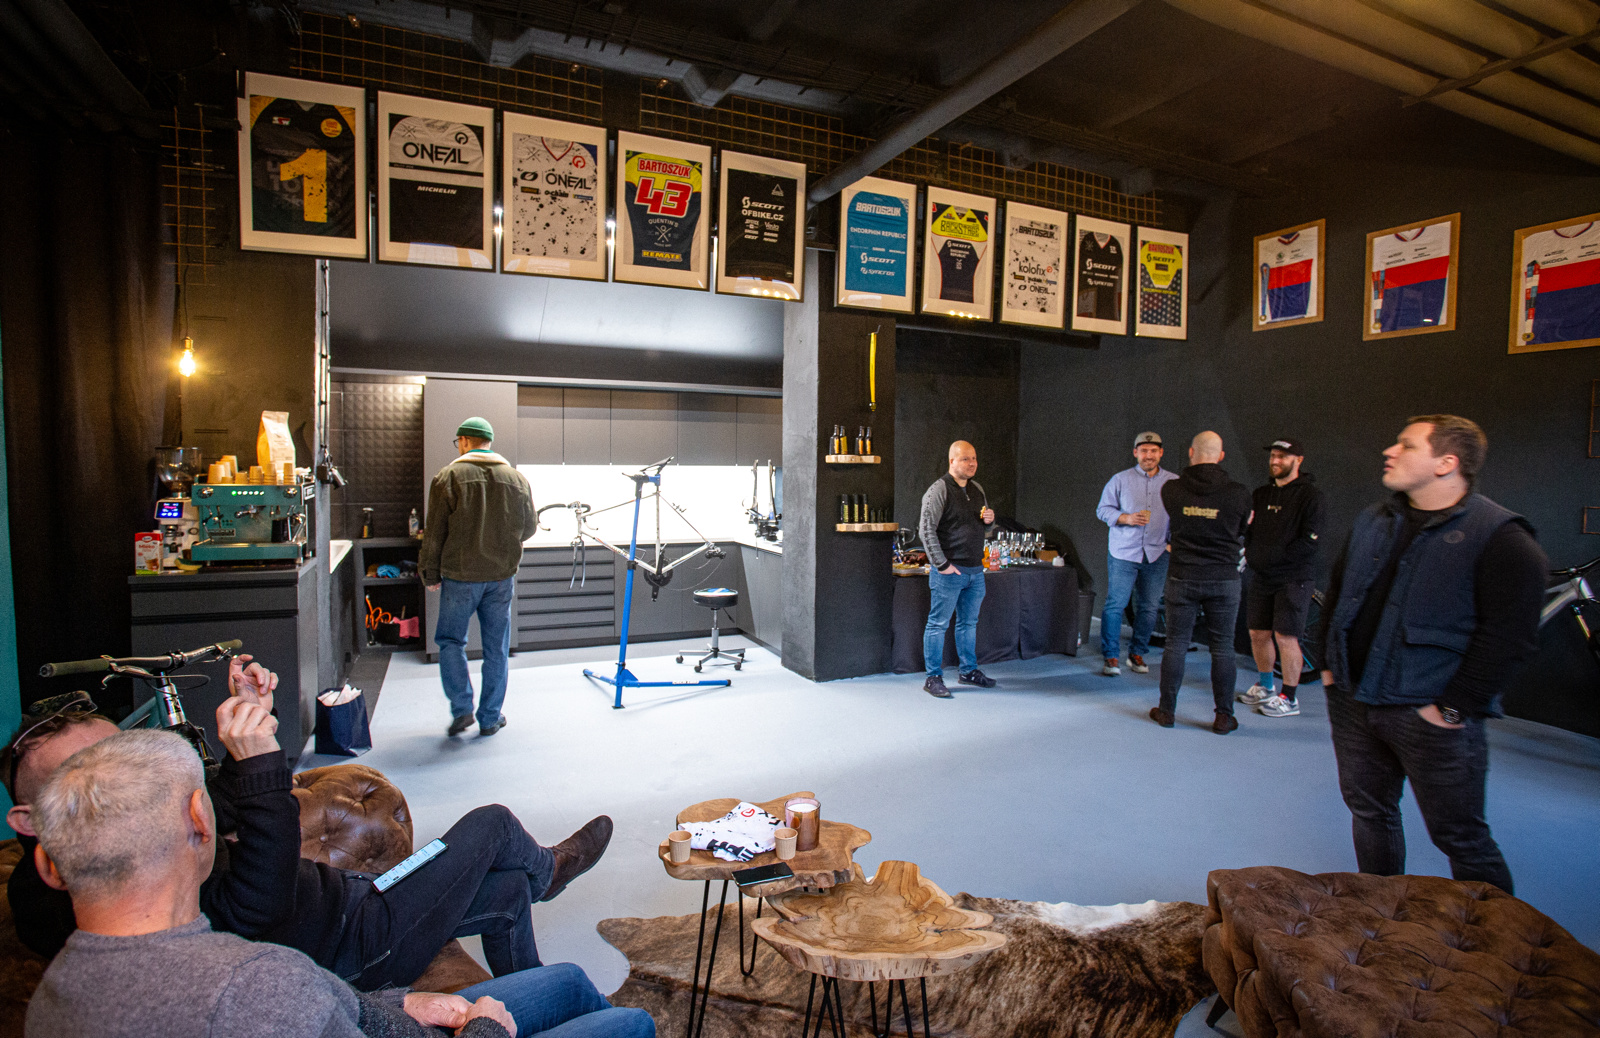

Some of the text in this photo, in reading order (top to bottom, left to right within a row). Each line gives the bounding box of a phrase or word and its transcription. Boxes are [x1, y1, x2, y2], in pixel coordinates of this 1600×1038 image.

[638, 159, 692, 178] BARTOSZUK
[280, 148, 327, 223] 1
[417, 185, 457, 195] MICHELIN
[634, 176, 693, 218] 43
[750, 201, 785, 211] SCOTT
[741, 209, 785, 222] OFBIKE.CZ
[642, 250, 682, 261] REMATE
[868, 256, 896, 265] SCOTT
[1018, 261, 1046, 276] kolofix
[1092, 262, 1117, 271] SCOTT
